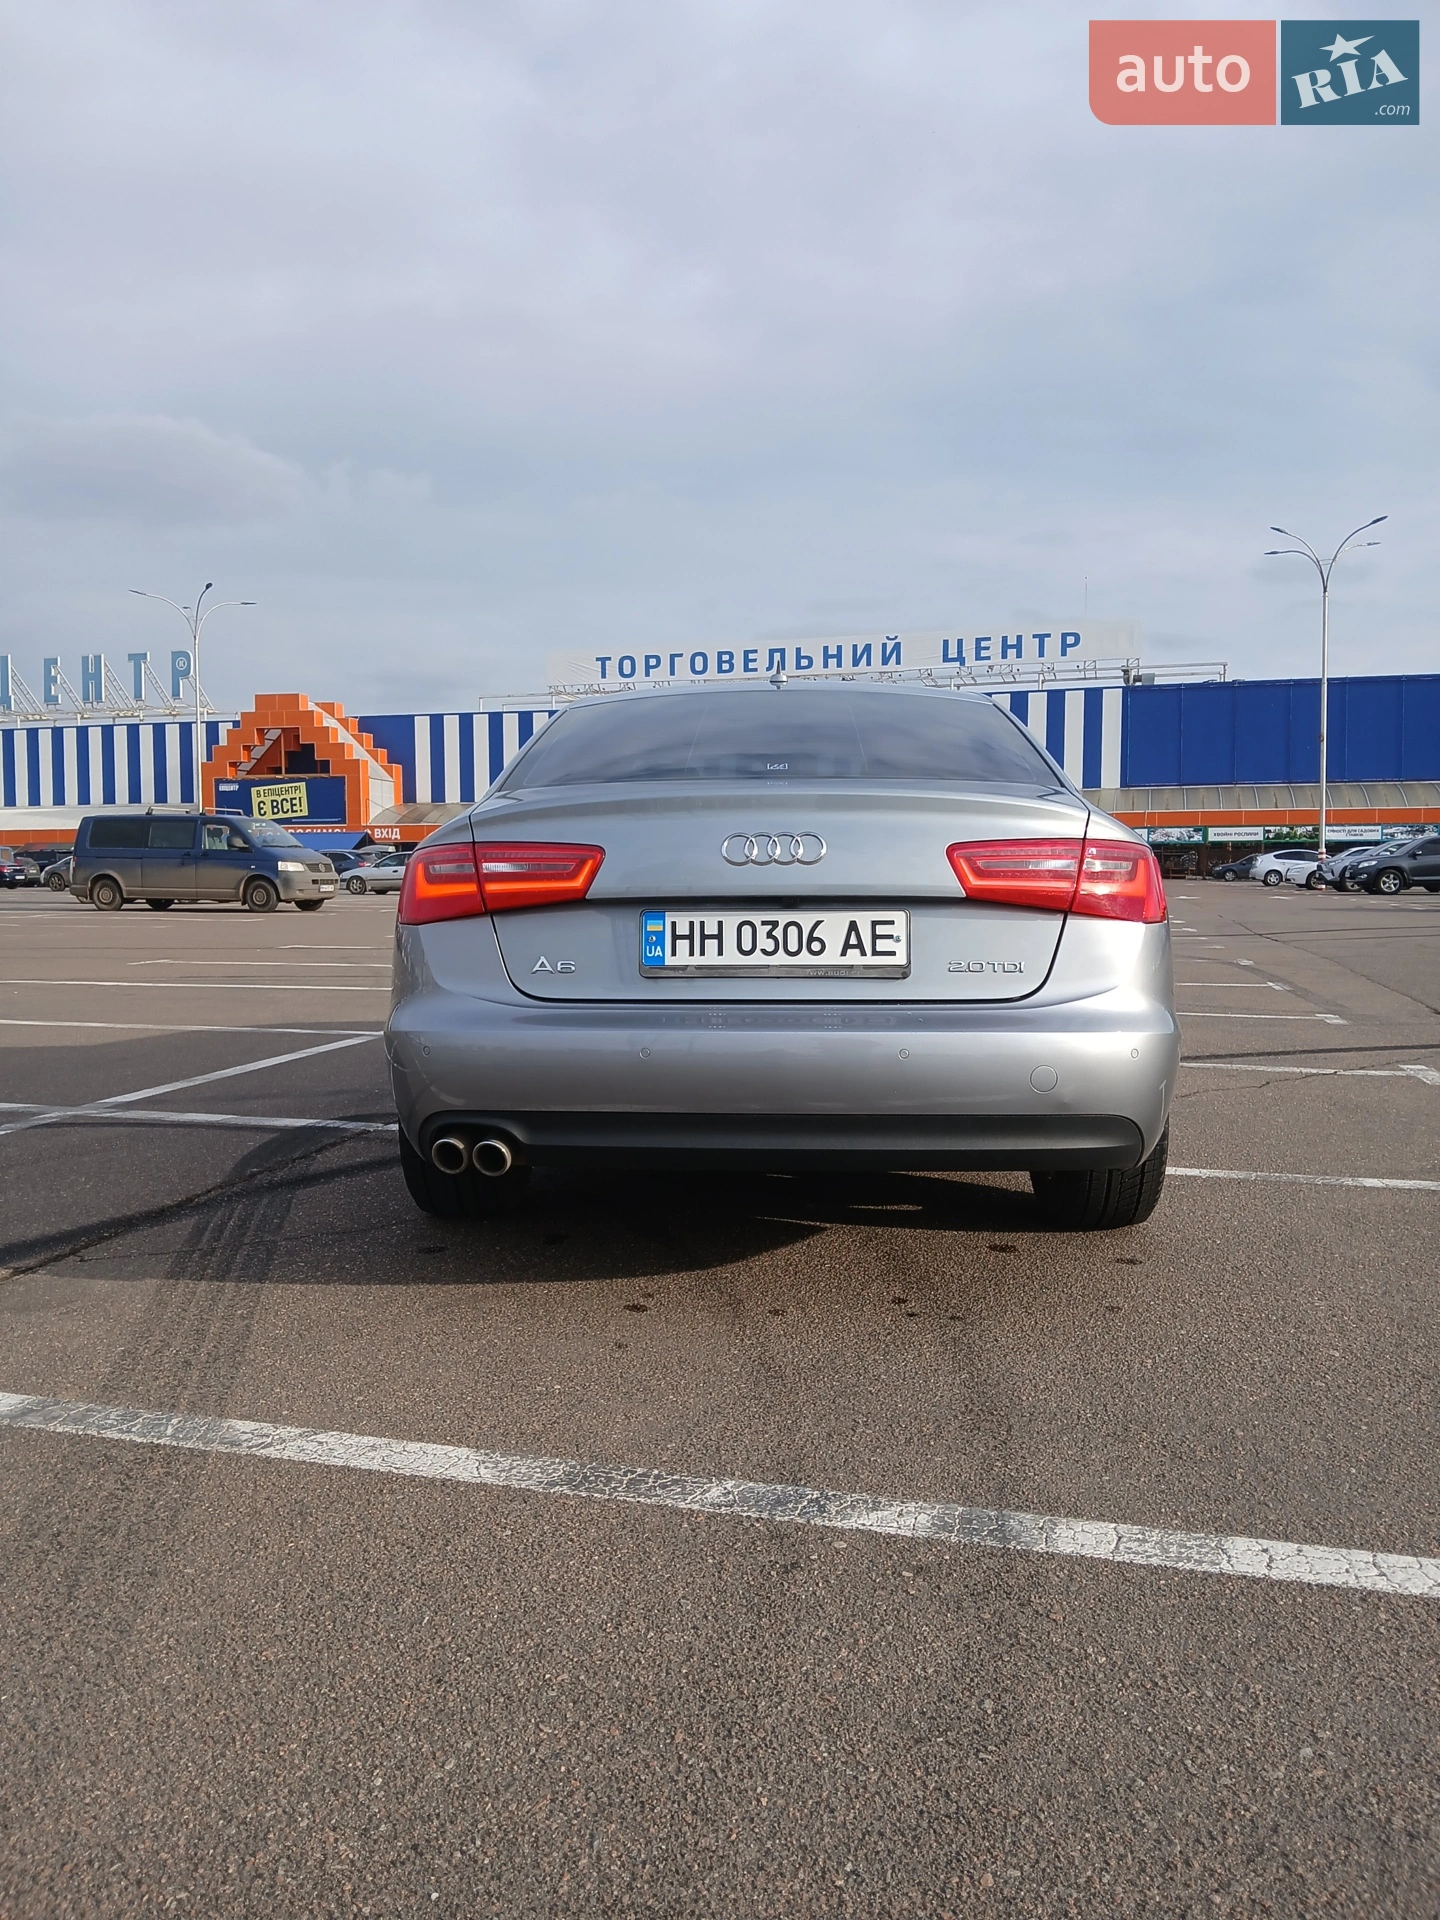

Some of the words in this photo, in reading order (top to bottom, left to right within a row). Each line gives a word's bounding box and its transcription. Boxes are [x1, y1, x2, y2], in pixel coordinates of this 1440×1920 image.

[595, 635, 902, 680] ТОРГОВЕЛЬНИЙ
[942, 632, 1081, 666] ЦЕНТР
[256, 789, 262, 798] В
[263, 785, 302, 798] ЕПІЦЕНТРІ
[257, 800, 267, 817] Є
[270, 796, 303, 815] ВСЕ!
[374, 828, 401, 840] ВХІД
[670, 920, 724, 957] HH
[736, 920, 827, 957] 0306
[839, 920, 897, 957] AE
[646, 946, 663, 957] UA
[531, 956, 576, 974] A6
